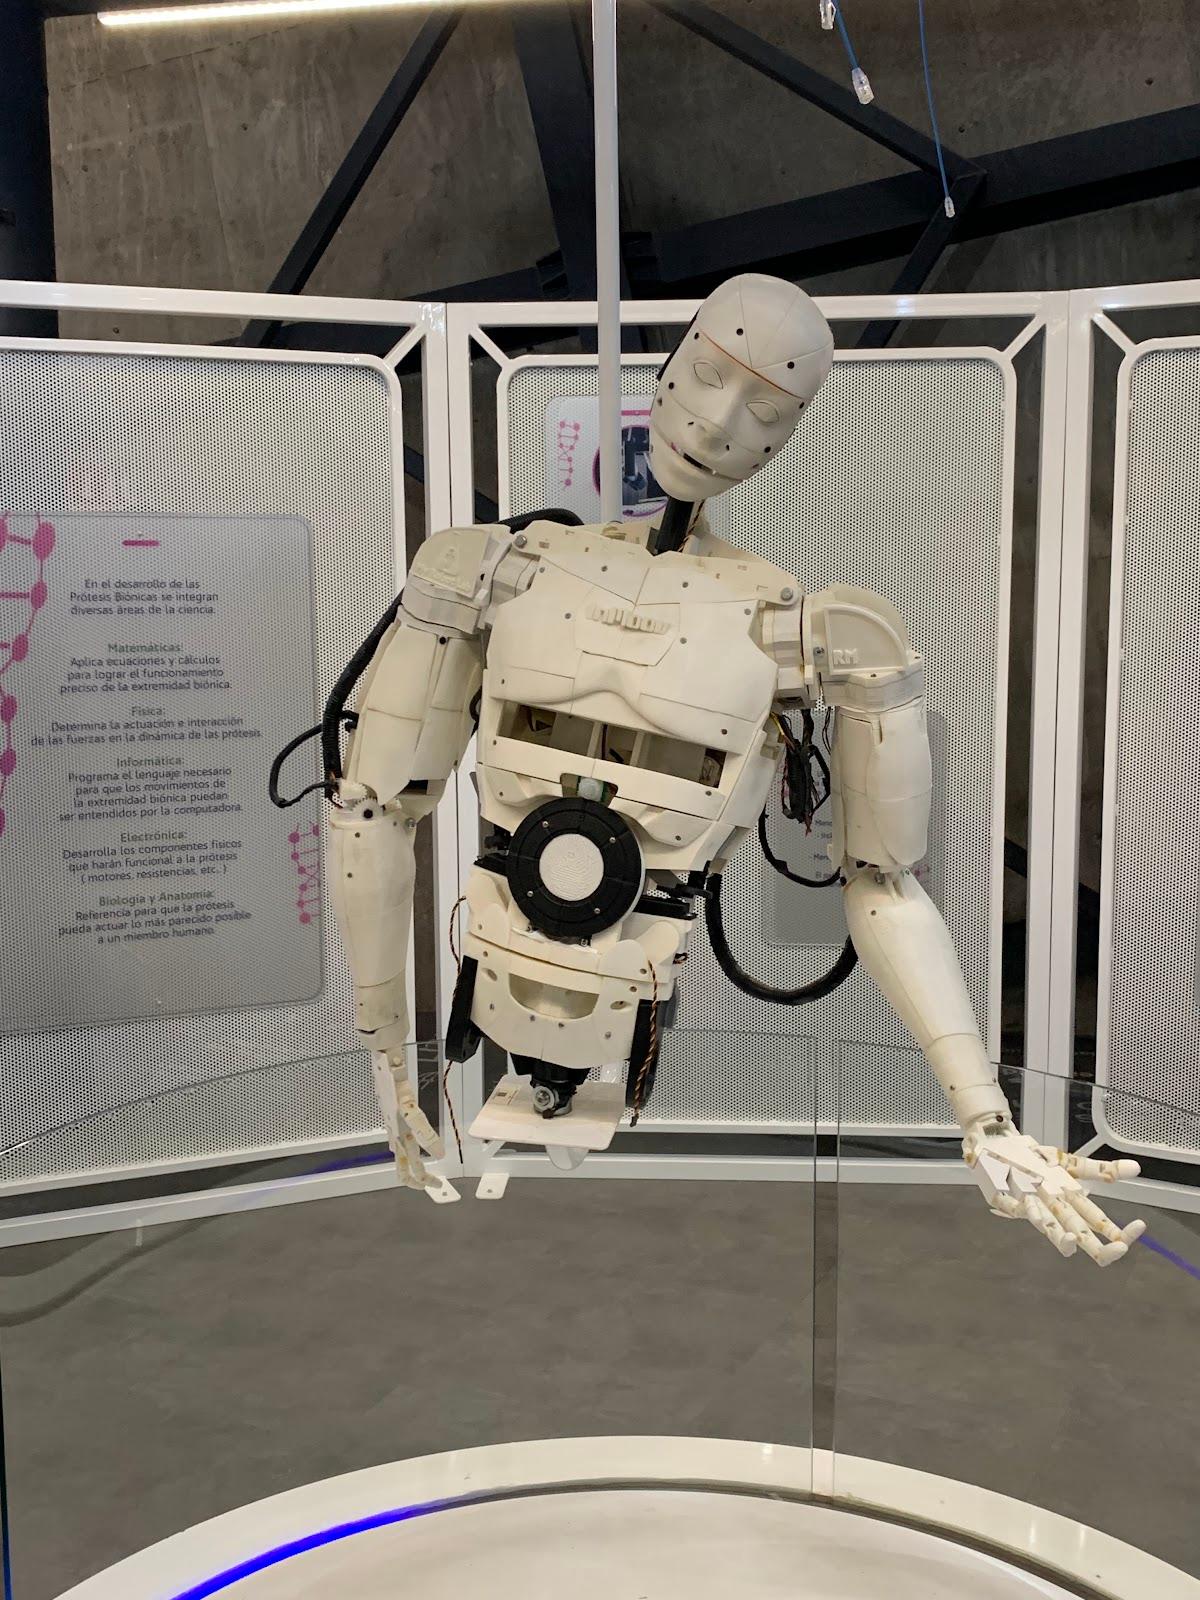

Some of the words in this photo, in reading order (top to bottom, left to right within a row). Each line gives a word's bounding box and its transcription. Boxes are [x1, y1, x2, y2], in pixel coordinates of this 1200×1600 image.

[85, 579, 97, 589] En
[101, 579, 110, 589] el
[114, 579, 166, 589] desarrollo
[169, 579, 182, 588] de
[186, 579, 199, 588] las
[70, 592, 111, 602] Prótesis
[115, 592, 157, 602] Biónicas
[161, 593, 172, 601] se
[176, 592, 218, 604] integran
[71, 606, 113, 615] diversas
[117, 605, 144, 615] áreas
[148, 605, 161, 614] de
[166, 606, 175, 614] la
[71, 658, 103, 668] Aplica
[107, 657, 165, 666] ecuaciones
[169, 658, 174, 666] y
[178, 656, 220, 665] cálculos
[68, 670, 91, 681] para
[95, 669, 125, 681] lograr
[130, 669, 139, 678] el
[143, 668, 224, 678] funcionamiento
[60, 683, 98, 694] preciso
[101, 683, 115, 692] de
[118, 682, 128, 691] la
[131, 681, 190, 691] extremidad
[193, 680, 231, 689] biónica.
[52, 721, 106, 732] Determina
[110, 720, 120, 730] la
[124, 719, 174, 729] actuación
[188, 717, 243, 727] interacción
[31, 736, 44, 746] de
[49, 735, 63, 745] las
[66, 734, 105, 745] fuerzas
[109, 735, 122, 743] en
[126, 733, 135, 742] la
[139, 731, 184, 742] dinámica
[188, 730, 201, 740] de
[205, 729, 219, 739] las
[68, 772, 118, 783] Programa
[122, 771, 132, 780] el
[136, 770, 180, 781] lenguaje
[184, 767, 231, 777] necesario
[76, 786, 99, 796] para
[102, 785, 122, 795] que
[126, 784, 140, 793] los
[145, 781, 209, 792] movimientos
[213, 779, 225, 789] de
[74, 798, 83, 808] la
[88, 795, 146, 807] extremidad
[150, 793, 186, 804] biónica
[191, 792, 227, 804] puedan
[60, 812, 74, 822] ser
[78, 809, 137, 821] entendidos
[141, 809, 157, 819] por
[161, 806, 170, 816] la
[63, 847, 117, 859] Desarrolla
[121, 846, 135, 855] los
[139, 842, 208, 854] componentes
[211, 839, 242, 849] físicos
[69, 862, 88, 873] que
[92, 859, 122, 870] harán
[125, 856, 172, 868] funcional
[186, 854, 195, 864] la
[199, 852, 237, 863] prótesis
[99, 895, 145, 907] Biología
[150, 896, 155, 905] y
[76, 910, 131, 921] Referencia
[135, 908, 156, 918] para
[161, 906, 180, 916] que
[183, 903, 192, 913] la
[196, 901, 234, 913] prótesis
[58, 925, 91, 937] pueda
[96, 922, 128, 932] actuar
[132, 920, 141, 929] lo
[145, 918, 165, 928] más
[169, 915, 212, 927] parecido
[216, 911, 252, 922] posible
[108, 935, 121, 944] un
[124, 929, 169, 941] miembro
